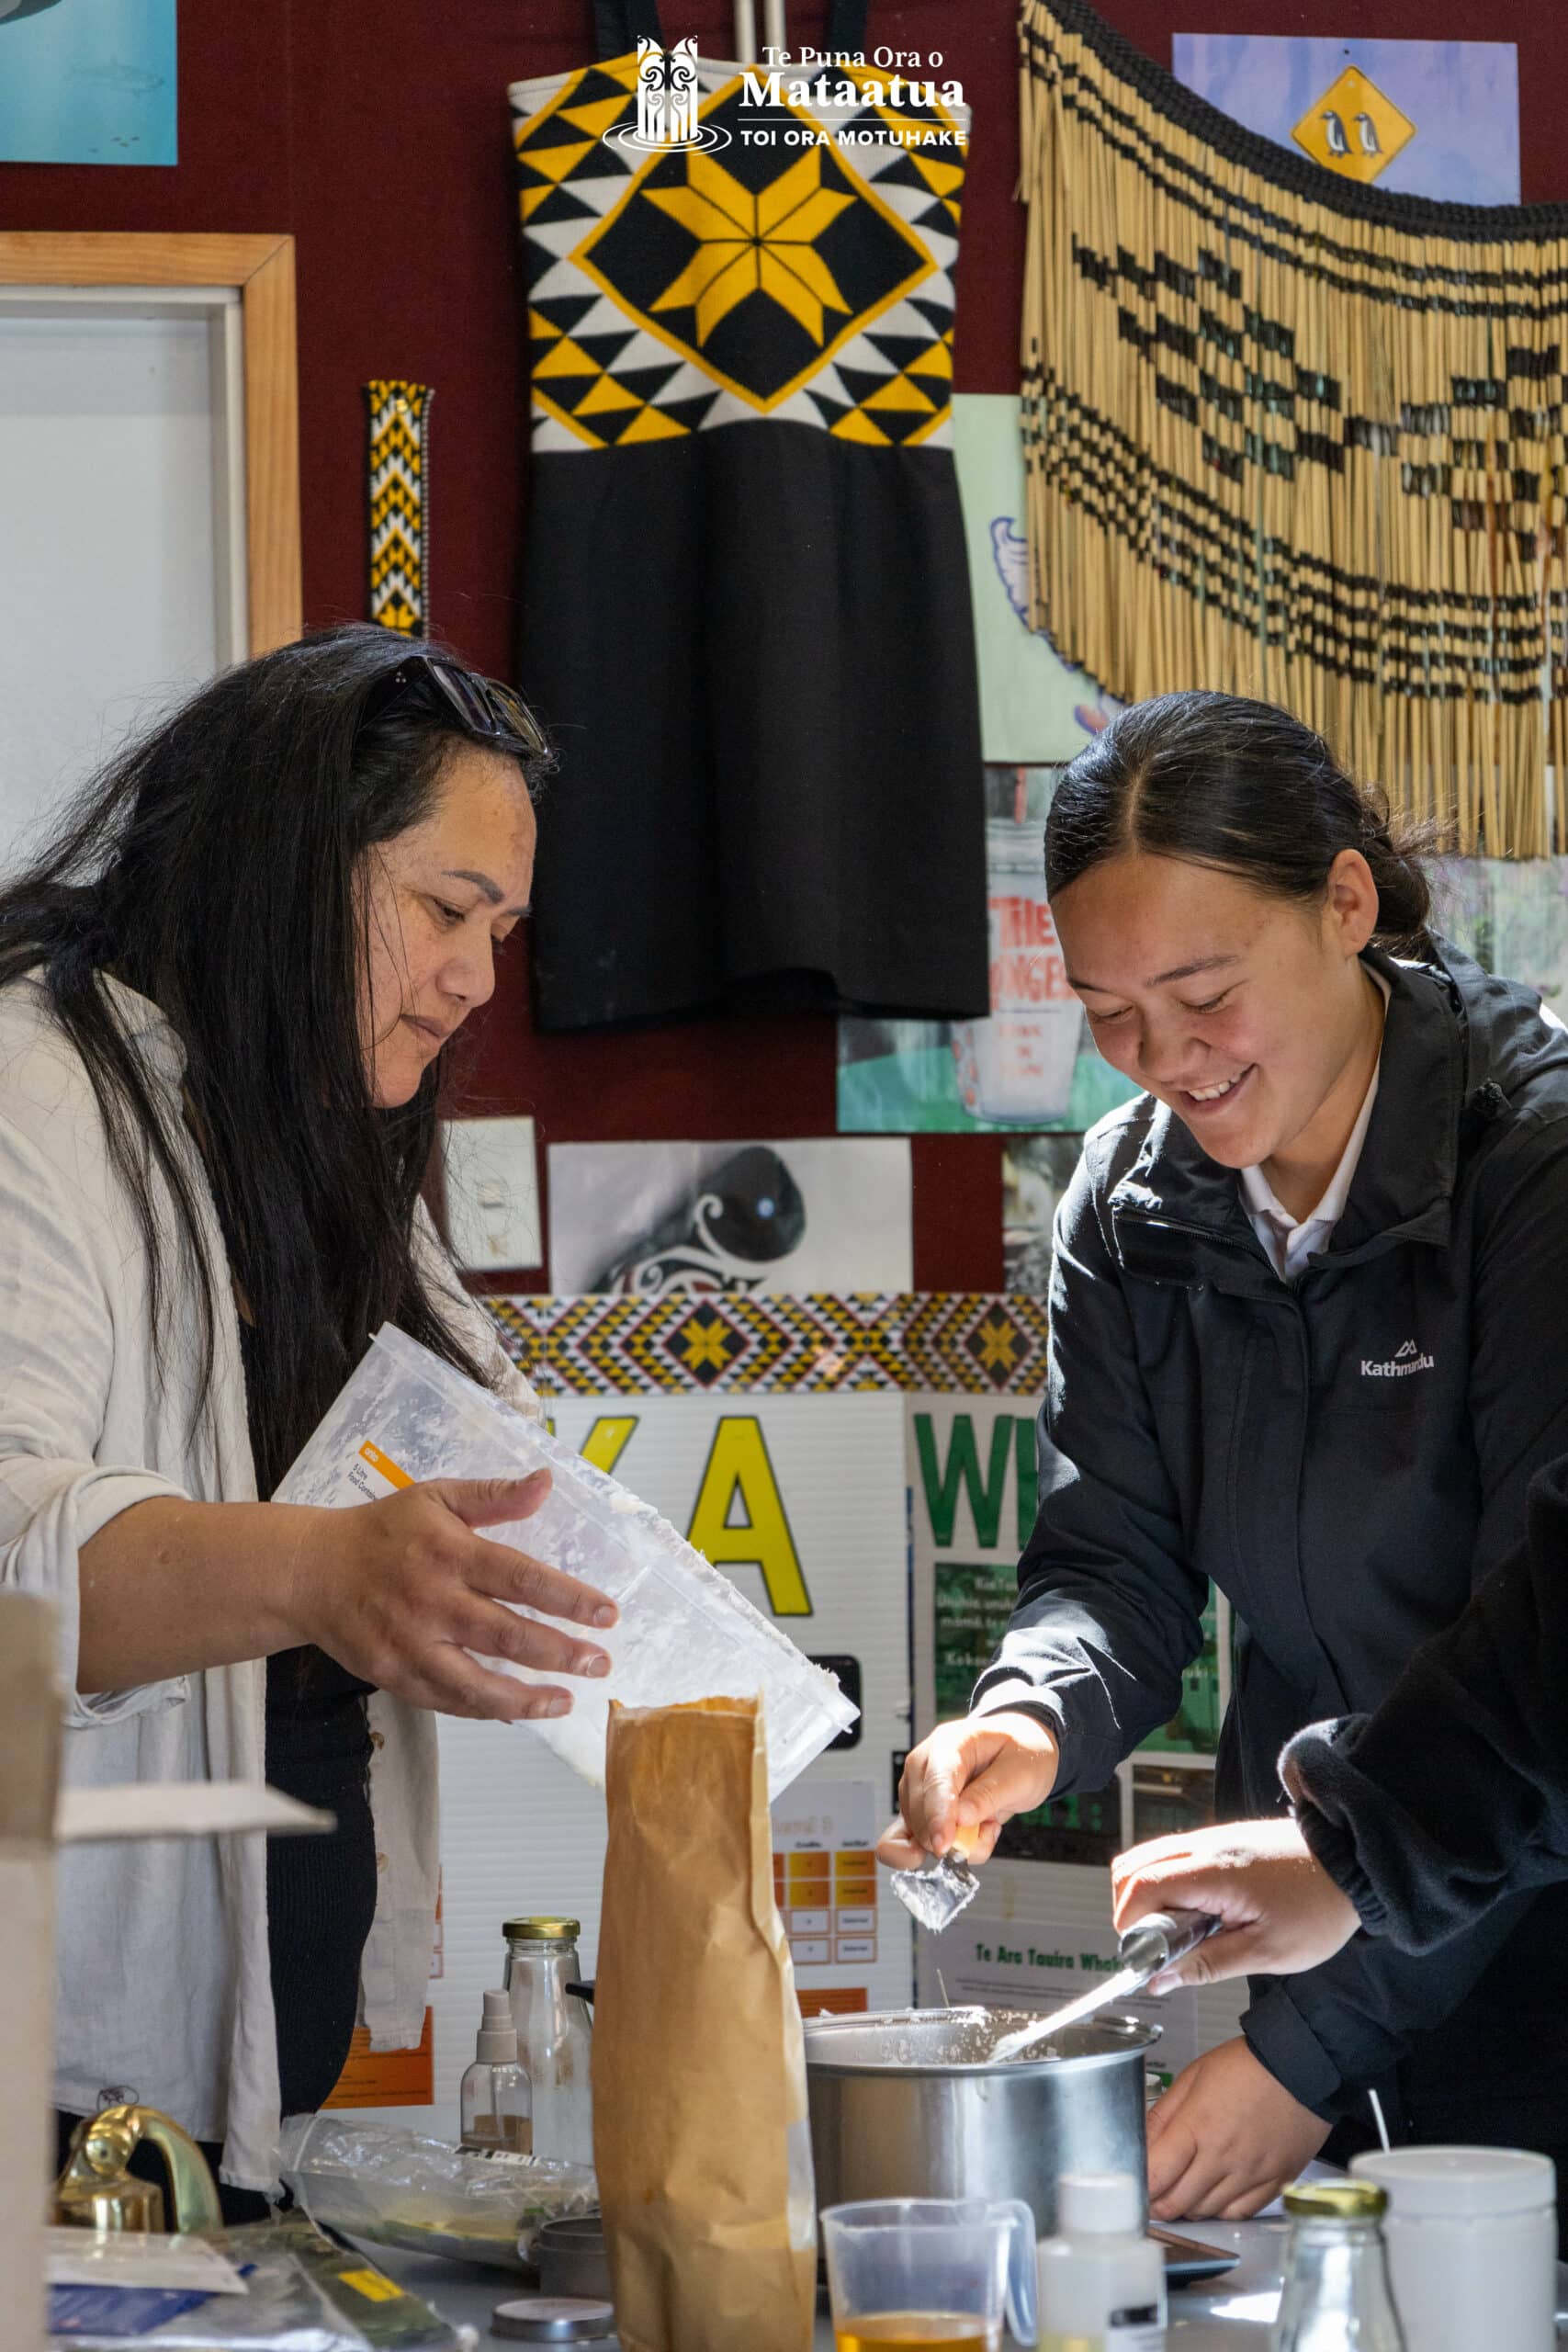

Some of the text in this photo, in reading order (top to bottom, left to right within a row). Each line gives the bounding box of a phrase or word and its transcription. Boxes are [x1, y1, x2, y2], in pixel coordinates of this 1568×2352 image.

[1360, 1352, 1434, 1376] Kathmandu
[347, 1470, 361, 1486] Food
[976, 1943, 992, 1962] Te
[998, 1946, 1022, 1965] Ara
[1029, 1948, 1075, 1969] Tauira
